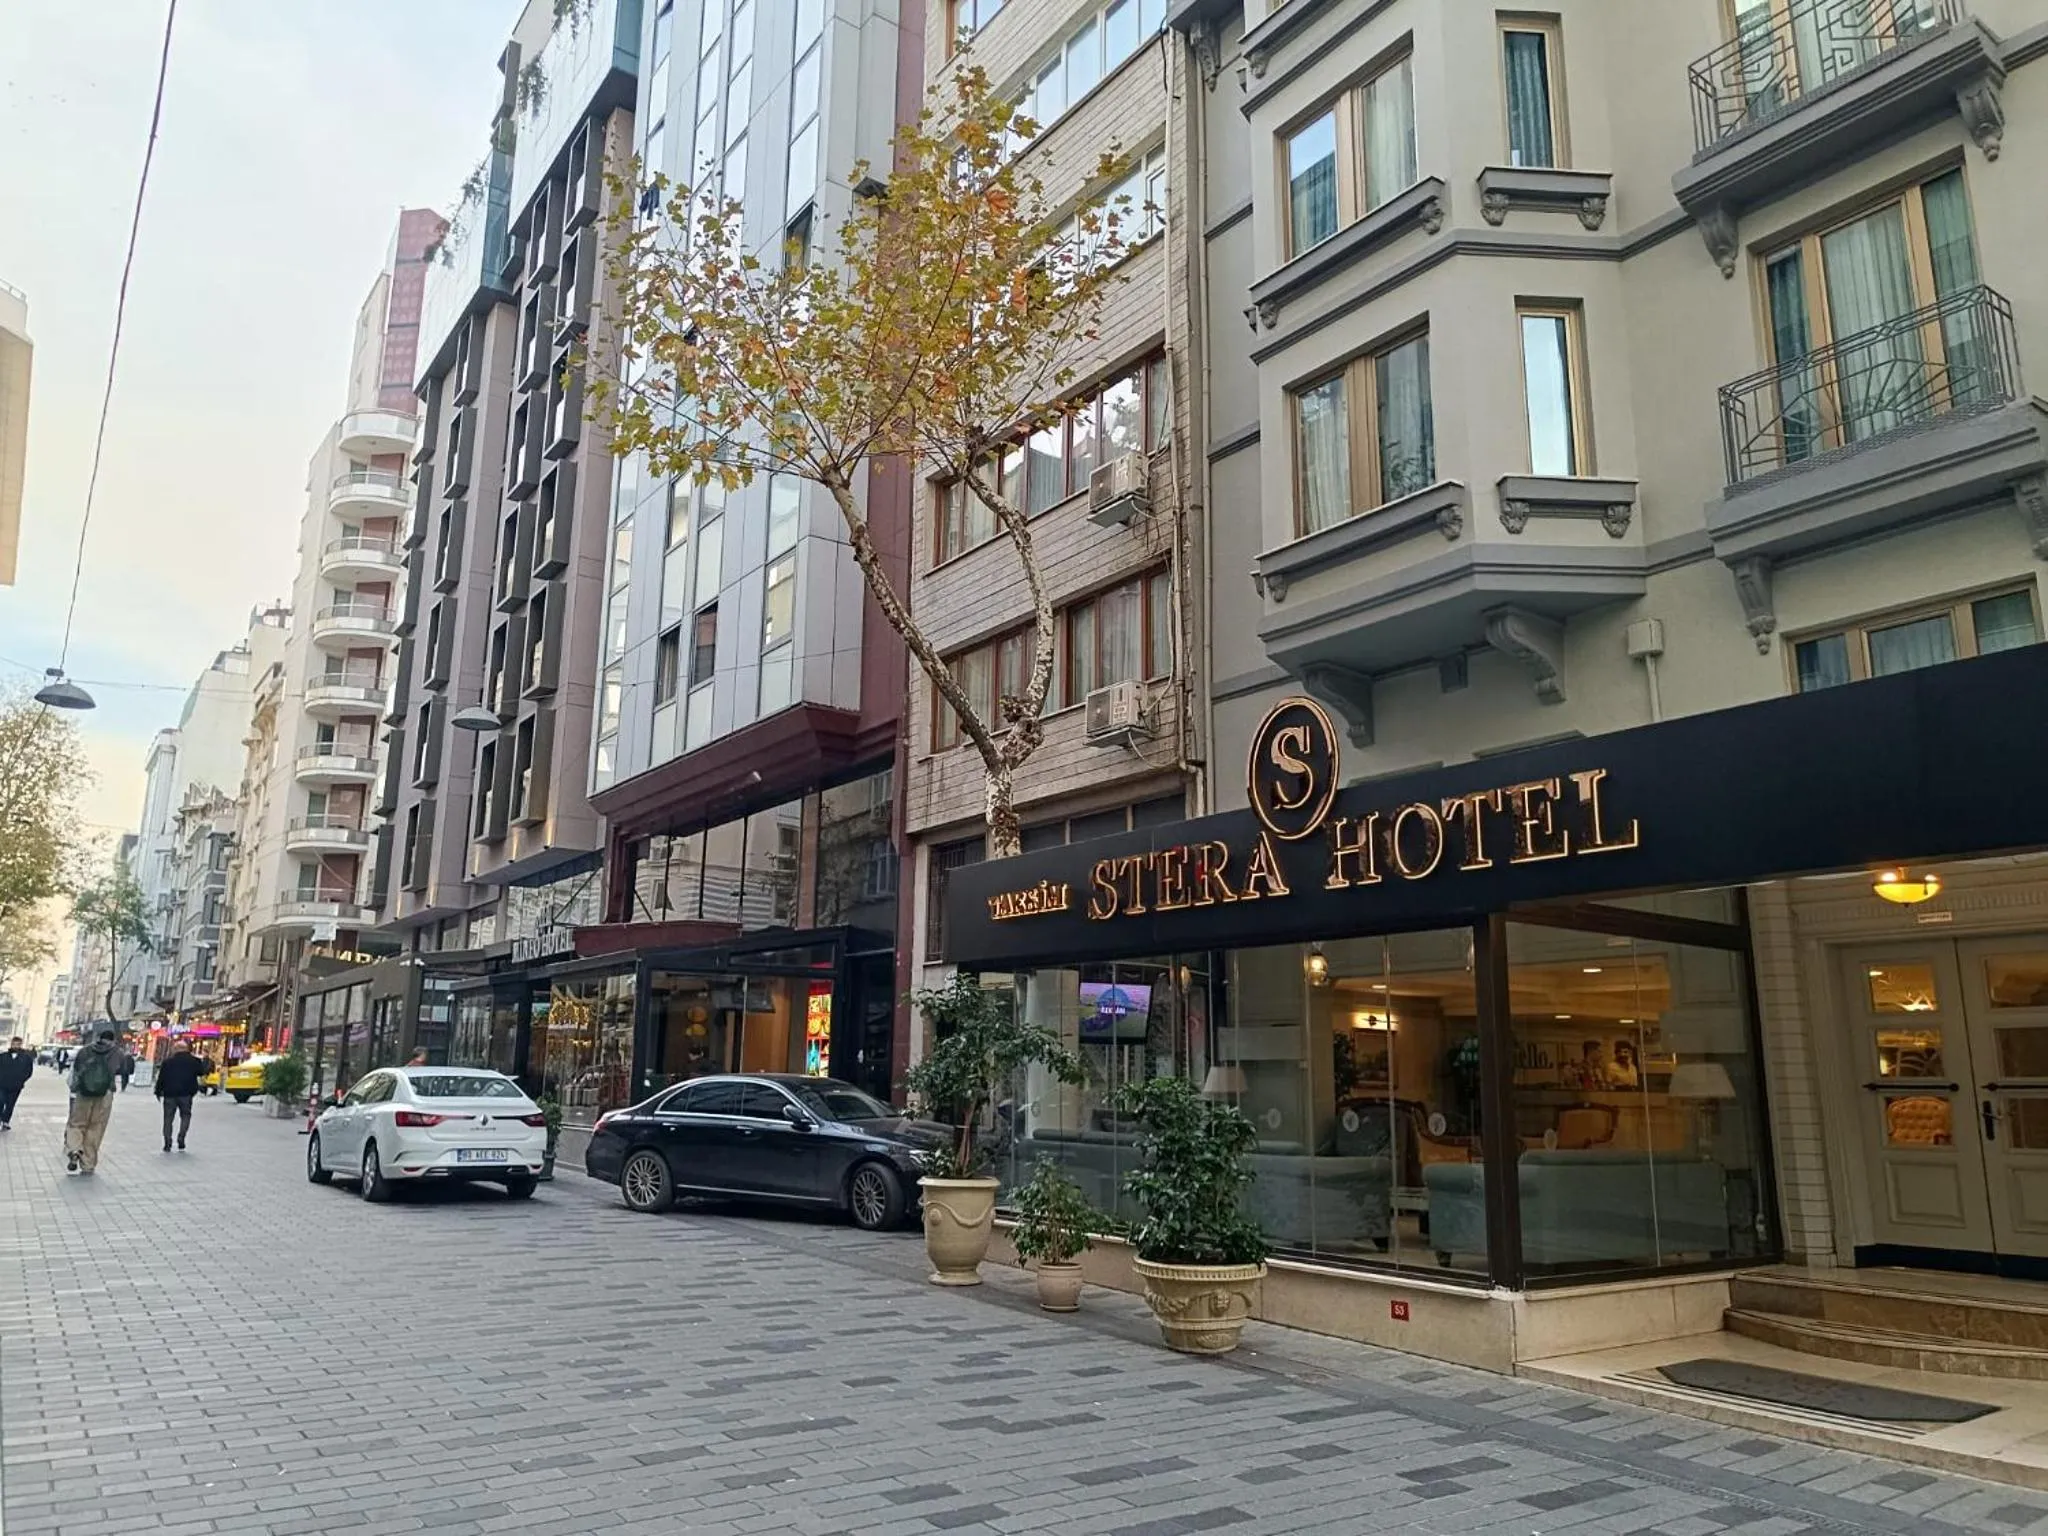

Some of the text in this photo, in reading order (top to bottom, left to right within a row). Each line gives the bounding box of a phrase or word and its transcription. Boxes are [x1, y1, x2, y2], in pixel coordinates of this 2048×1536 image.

[1271, 726, 1314, 810] S
[1088, 831, 1290, 920] STERA
[1323, 768, 1639, 890] HOTEL
